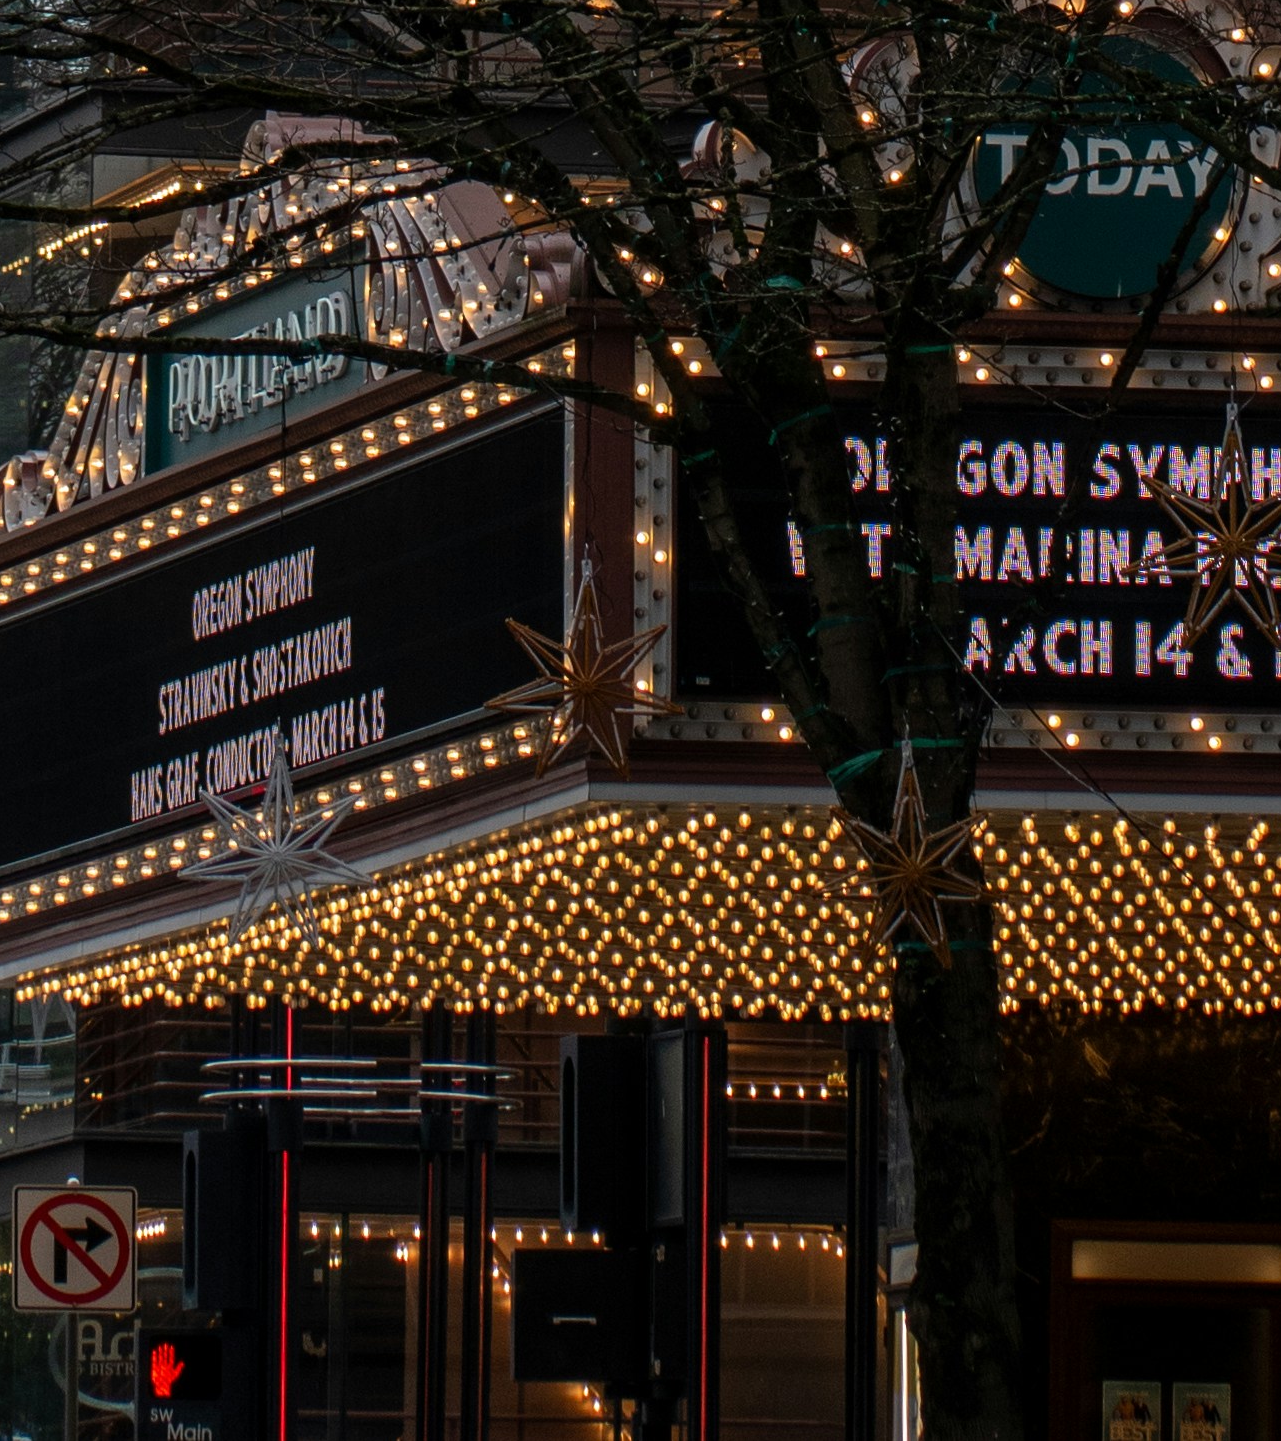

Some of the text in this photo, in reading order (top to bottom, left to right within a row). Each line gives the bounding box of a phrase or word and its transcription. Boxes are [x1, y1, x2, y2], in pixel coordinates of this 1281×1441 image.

[169, 291, 350, 442] PORTLAND
[192, 545, 315, 641] OREGON SYMPHONY
[159, 616, 351, 735] STRAVINSKY & SHOSTAKOVICH
[1135, 619, 1193, 676] 14
[1217, 621, 1252, 678] &
[131, 764, 162, 823] HANS
[292, 703, 338, 768] MARCH
[340, 696, 355, 751] 14
[359, 692, 368, 746] &
[372, 686, 386, 742] 15
[89, 1362, 135, 1377] BISTR
[150, 1407, 174, 1422] SW
